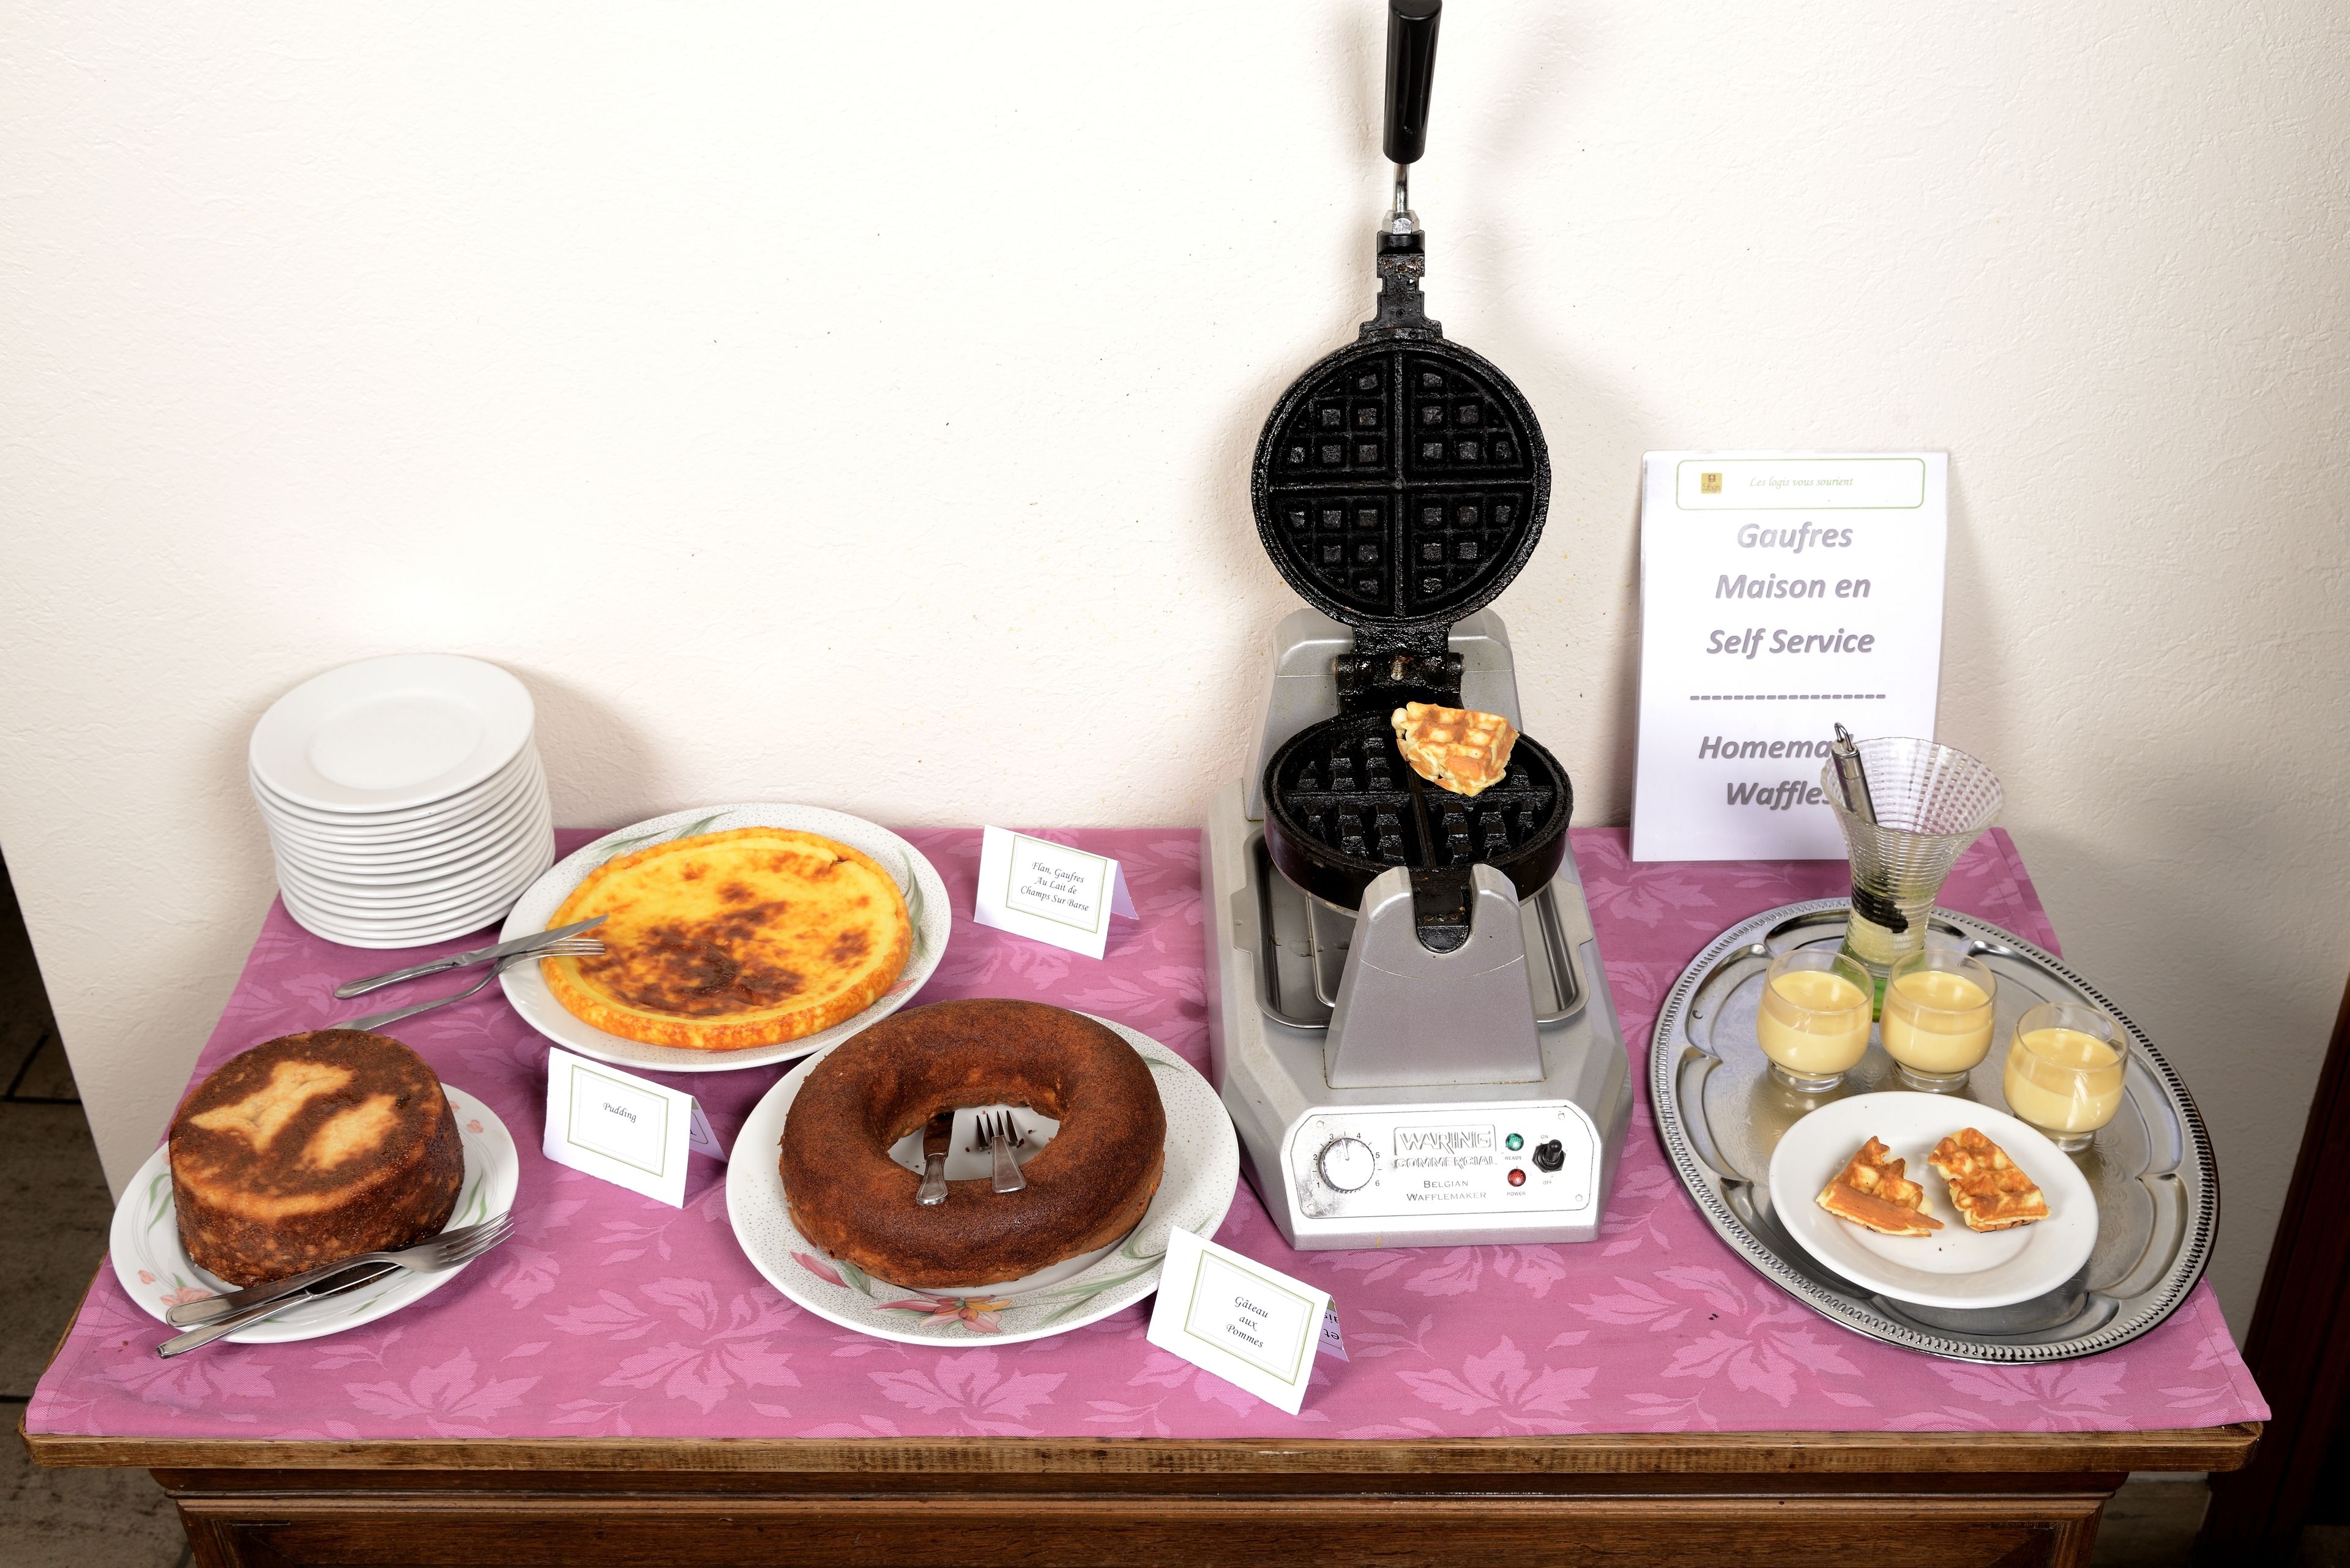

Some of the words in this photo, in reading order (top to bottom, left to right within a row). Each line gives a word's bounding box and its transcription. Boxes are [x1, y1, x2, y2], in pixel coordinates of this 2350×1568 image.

[1749, 477, 1766, 487] Les
[1768, 476, 1790, 490] logis
[1816, 476, 1854, 487] sourient
[1737, 521, 1854, 554] Gaufres
[1715, 573, 1826, 599] Maison
[1835, 578, 1871, 599] en
[1706, 627, 1765, 660] Self
[1769, 627, 1876, 654] Service
[1698, 734, 1854, 760] Homema
[1032, 861, 1051, 875] Flan,
[1054, 868, 1085, 884] Gaufres
[1034, 876, 1047, 887] Au
[1049, 879, 1066, 892] Lait
[1067, 885, 1077, 895] de
[1020, 885, 1051, 902] Champs
[1051, 894, 1067, 905] Sur
[1067, 898, 1089, 912] Barse
[602, 1102, 637, 1124] Pudding
[1400, 1130, 1492, 1155] WARING
[1395, 1155, 1498, 1170] COMMERCIAL
[1234, 1296, 1269, 1318] Gâteau
[1226, 1323, 1264, 1348] Pommes
[1239, 1316, 1258, 1332] aux
